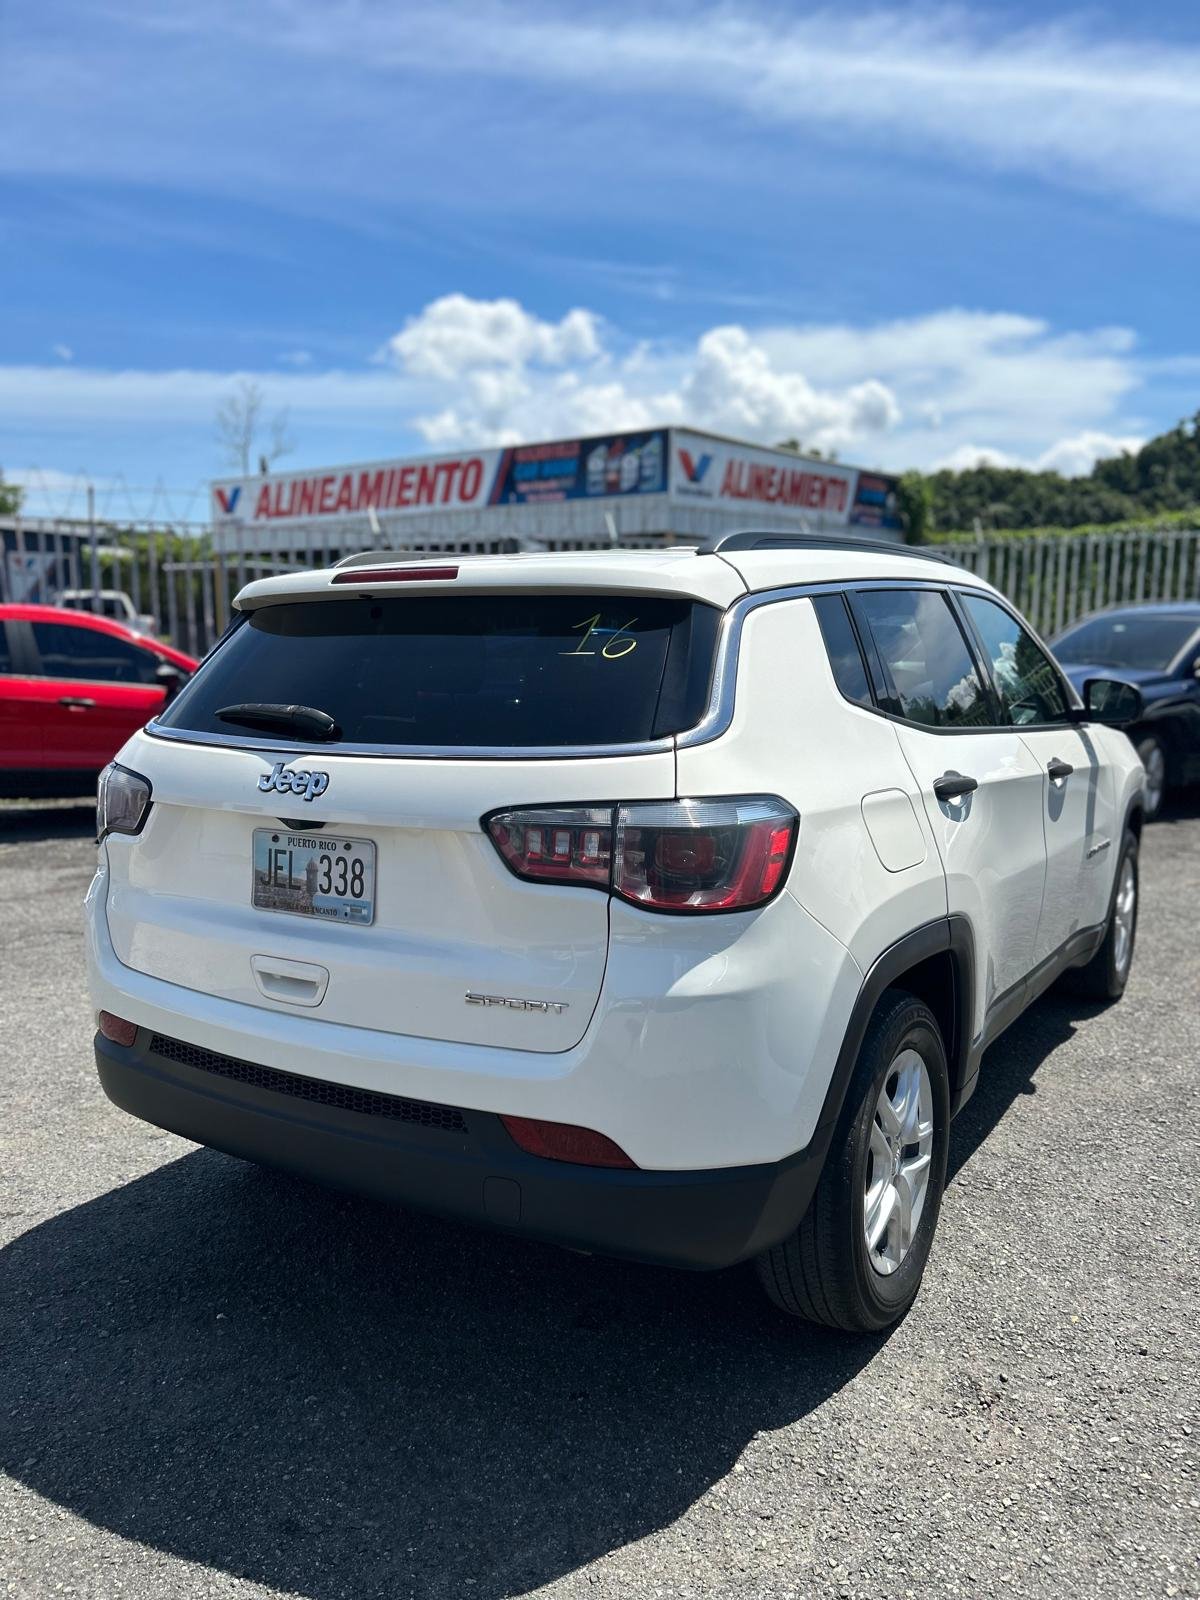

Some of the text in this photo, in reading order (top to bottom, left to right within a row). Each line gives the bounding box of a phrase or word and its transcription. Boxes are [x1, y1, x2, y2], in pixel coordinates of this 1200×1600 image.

[254, 457, 484, 519] ALINEAMIENTO
[719, 458, 848, 513] ALINEAMIENTO
[558, 613, 639, 659] 16
[257, 762, 330, 801] Jeep
[287, 836, 337, 852] PUERTO RICO
[260, 848, 365, 899] JEL 338
[464, 992, 569, 1014] SPORT
